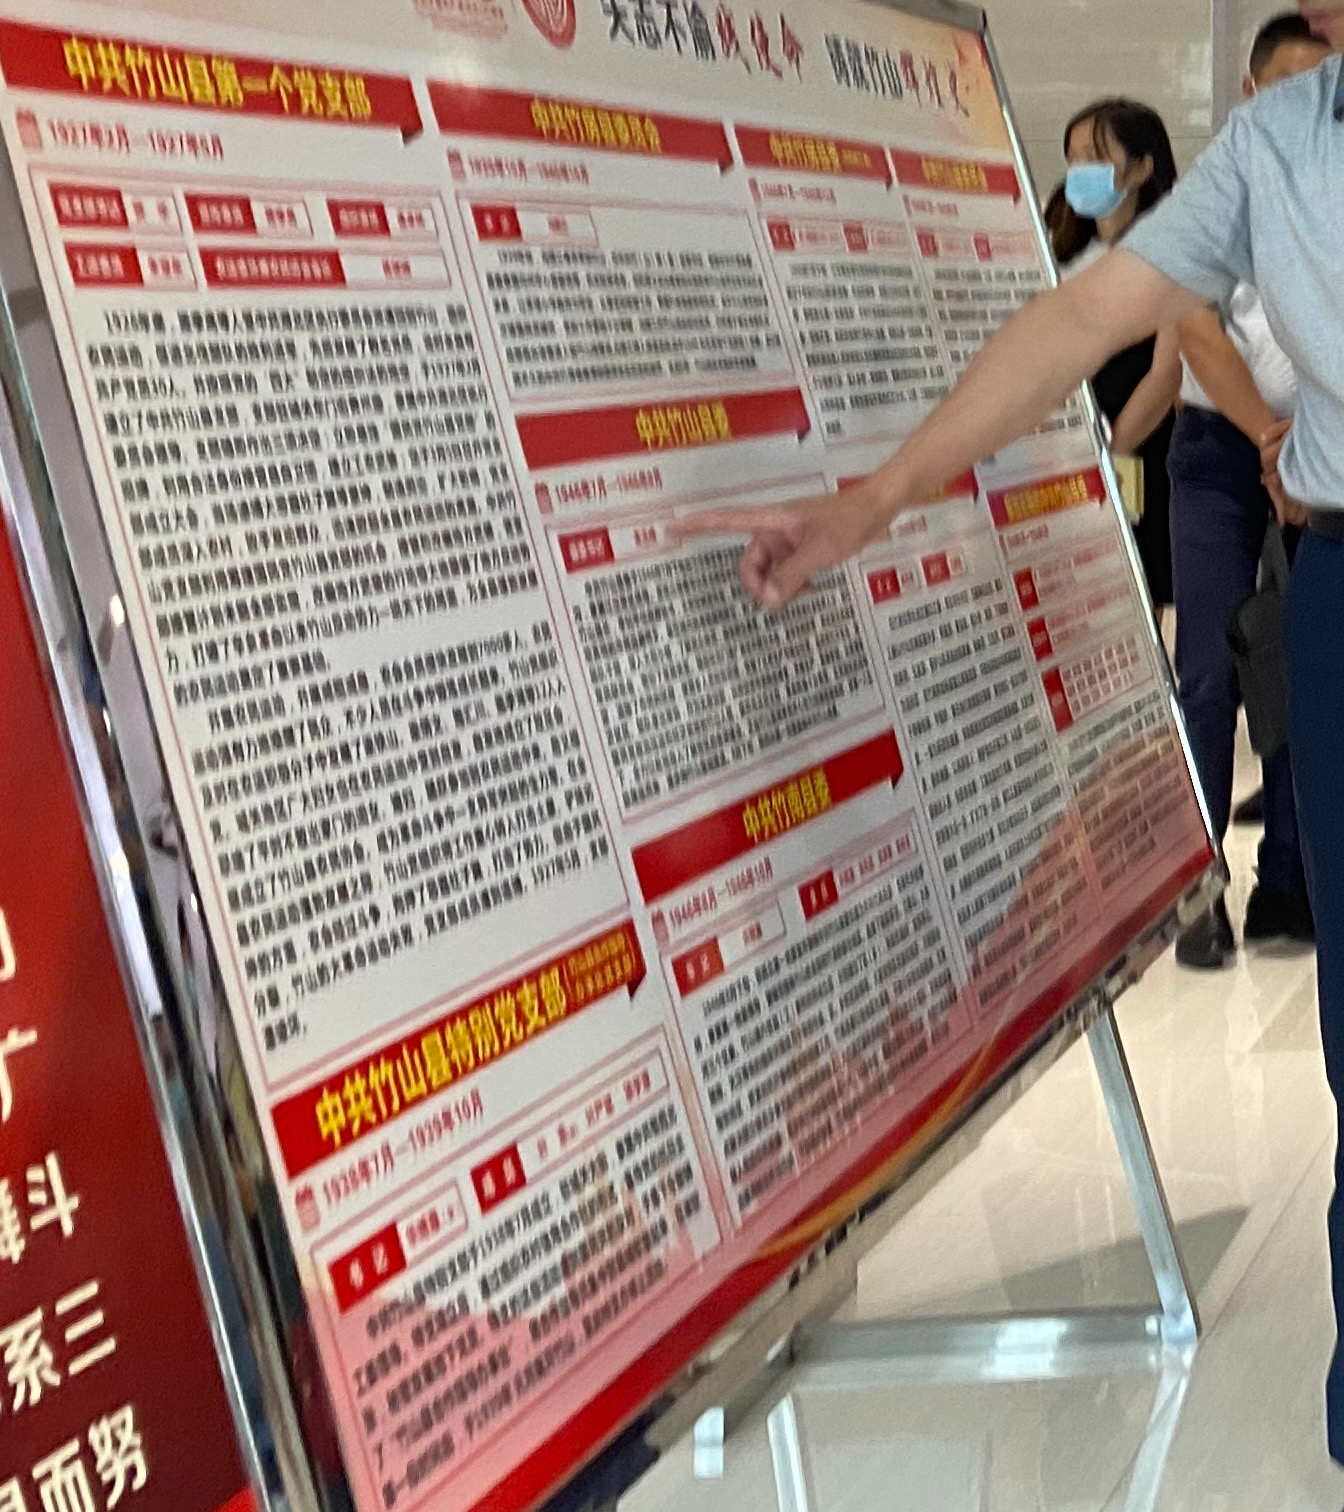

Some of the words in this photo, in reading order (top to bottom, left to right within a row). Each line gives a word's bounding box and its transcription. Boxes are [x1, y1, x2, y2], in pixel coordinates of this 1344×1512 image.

[63, 37, 372, 120] 中共竹山县第一个党支部
[316, 968, 567, 1148] 中共竹山县特别党支部
